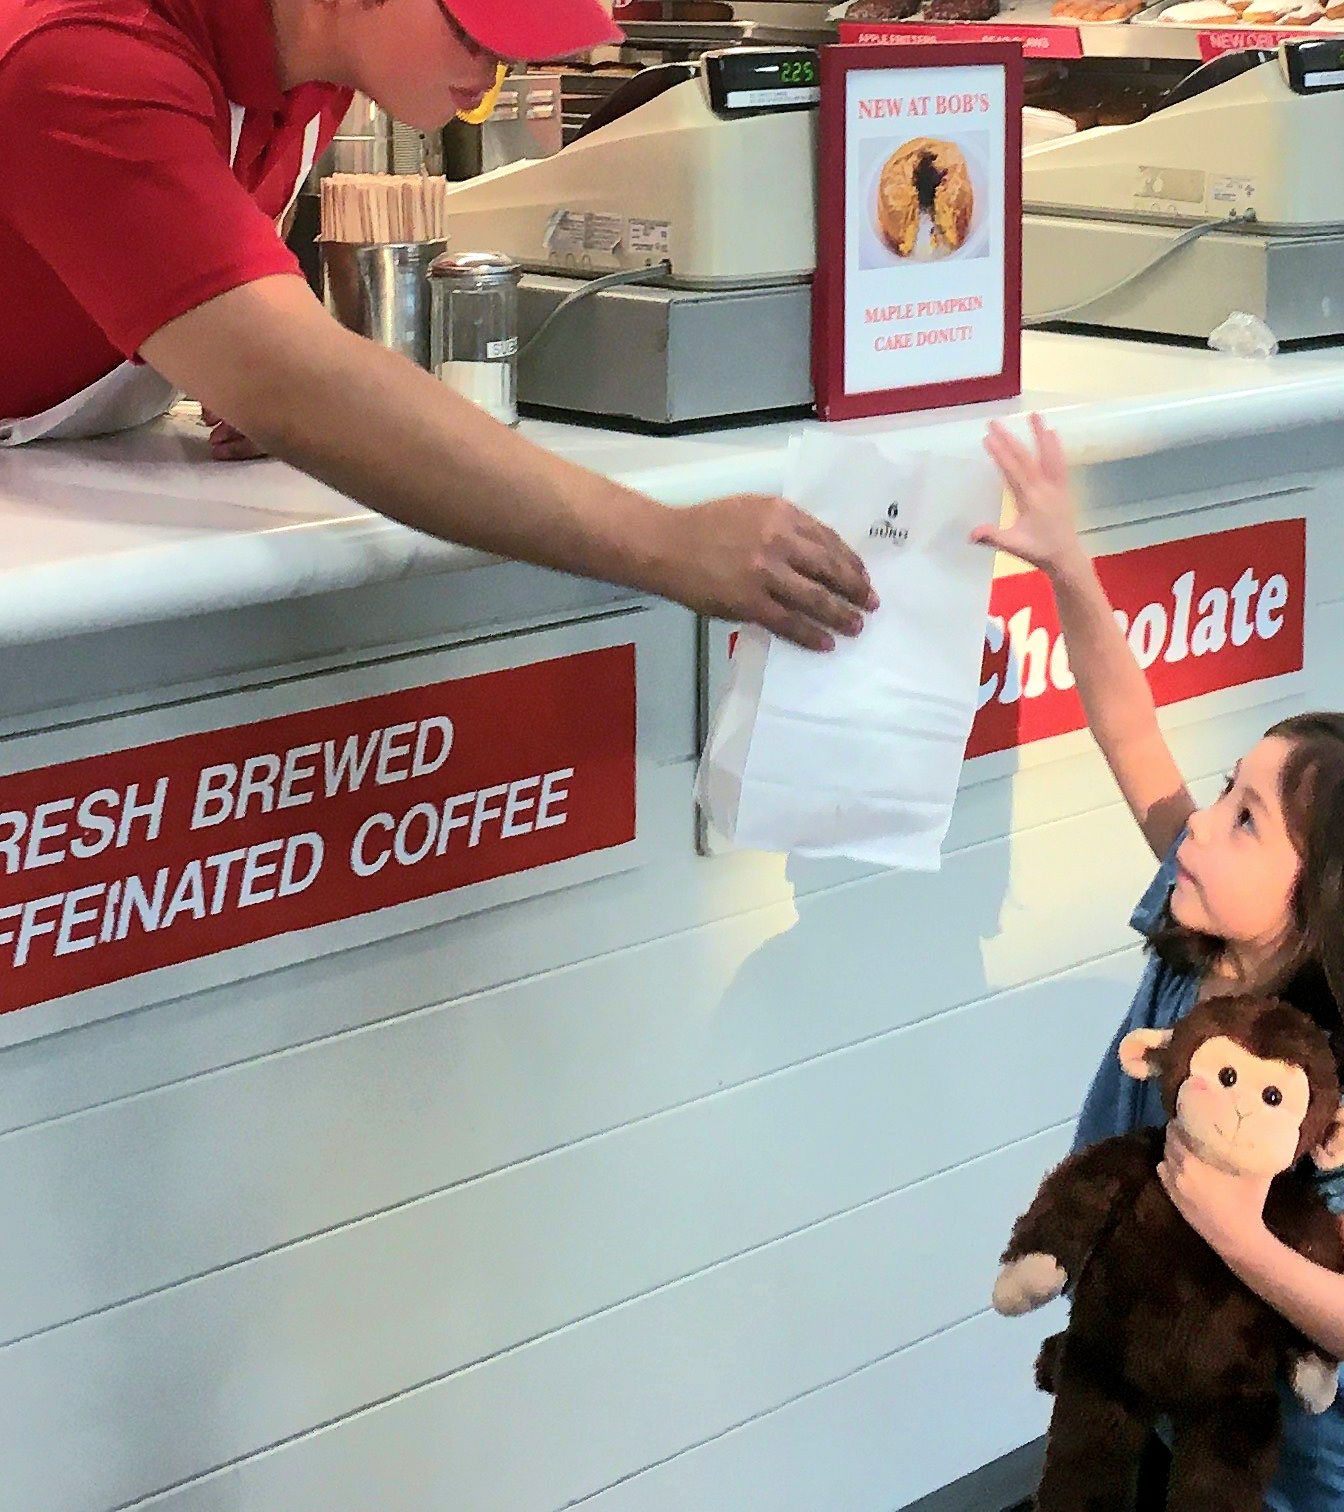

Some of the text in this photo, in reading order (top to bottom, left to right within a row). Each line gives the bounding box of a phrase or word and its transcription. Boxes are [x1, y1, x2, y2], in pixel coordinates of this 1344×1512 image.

[857, 92, 991, 120] NEW AT BOB'S
[863, 295, 984, 324] MAPLE PUMPKIN
[873, 332, 913, 353] CAKE
[978, 566, 1290, 706] Choolate
[190, 714, 456, 831] BREWED
[347, 767, 575, 880] COFFEE
